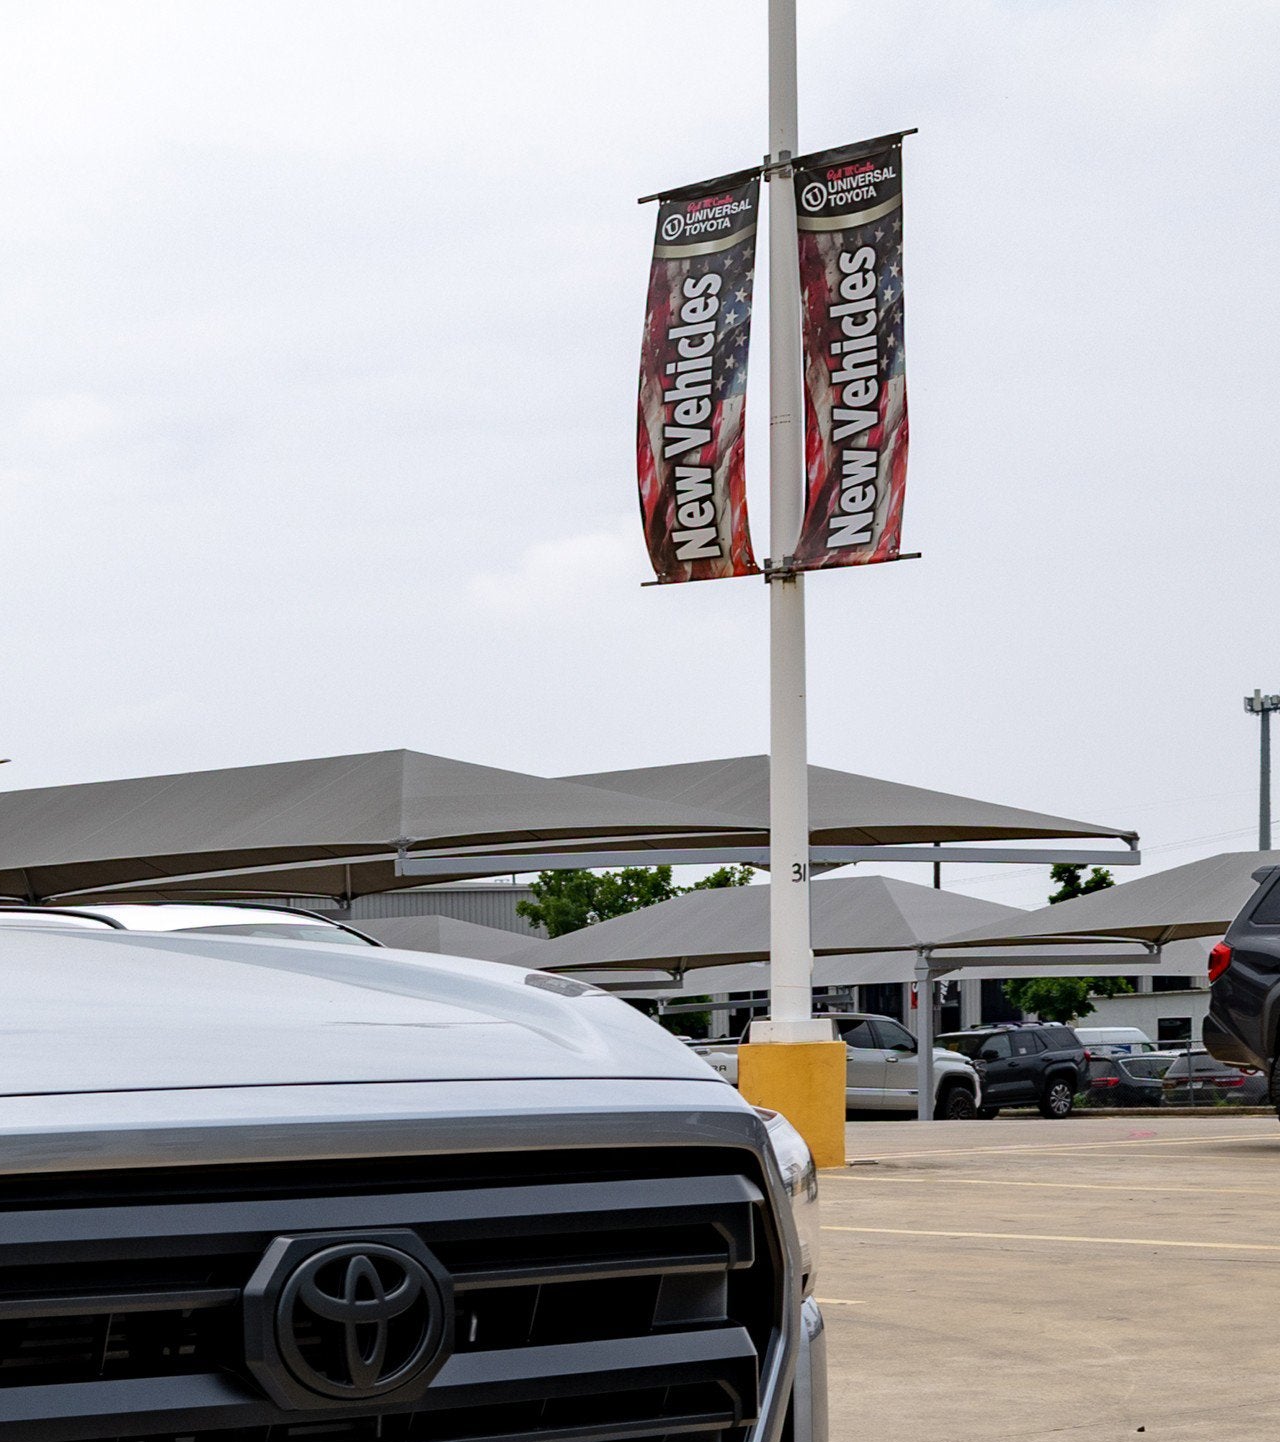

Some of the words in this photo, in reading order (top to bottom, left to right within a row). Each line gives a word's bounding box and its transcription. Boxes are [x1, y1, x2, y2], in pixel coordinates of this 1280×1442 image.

[827, 166, 897, 193] UNIVERSAL
[828, 185, 877, 207] TOYOTA
[685, 198, 752, 224] UNIVERSAL
[684, 217, 731, 237] TOYOTA
[829, 246, 879, 442] Vehicles
[663, 272, 723, 459] Vehicles
[825, 449, 878, 549] New
[669, 465, 722, 562] New
[792, 863, 806, 883] 31
